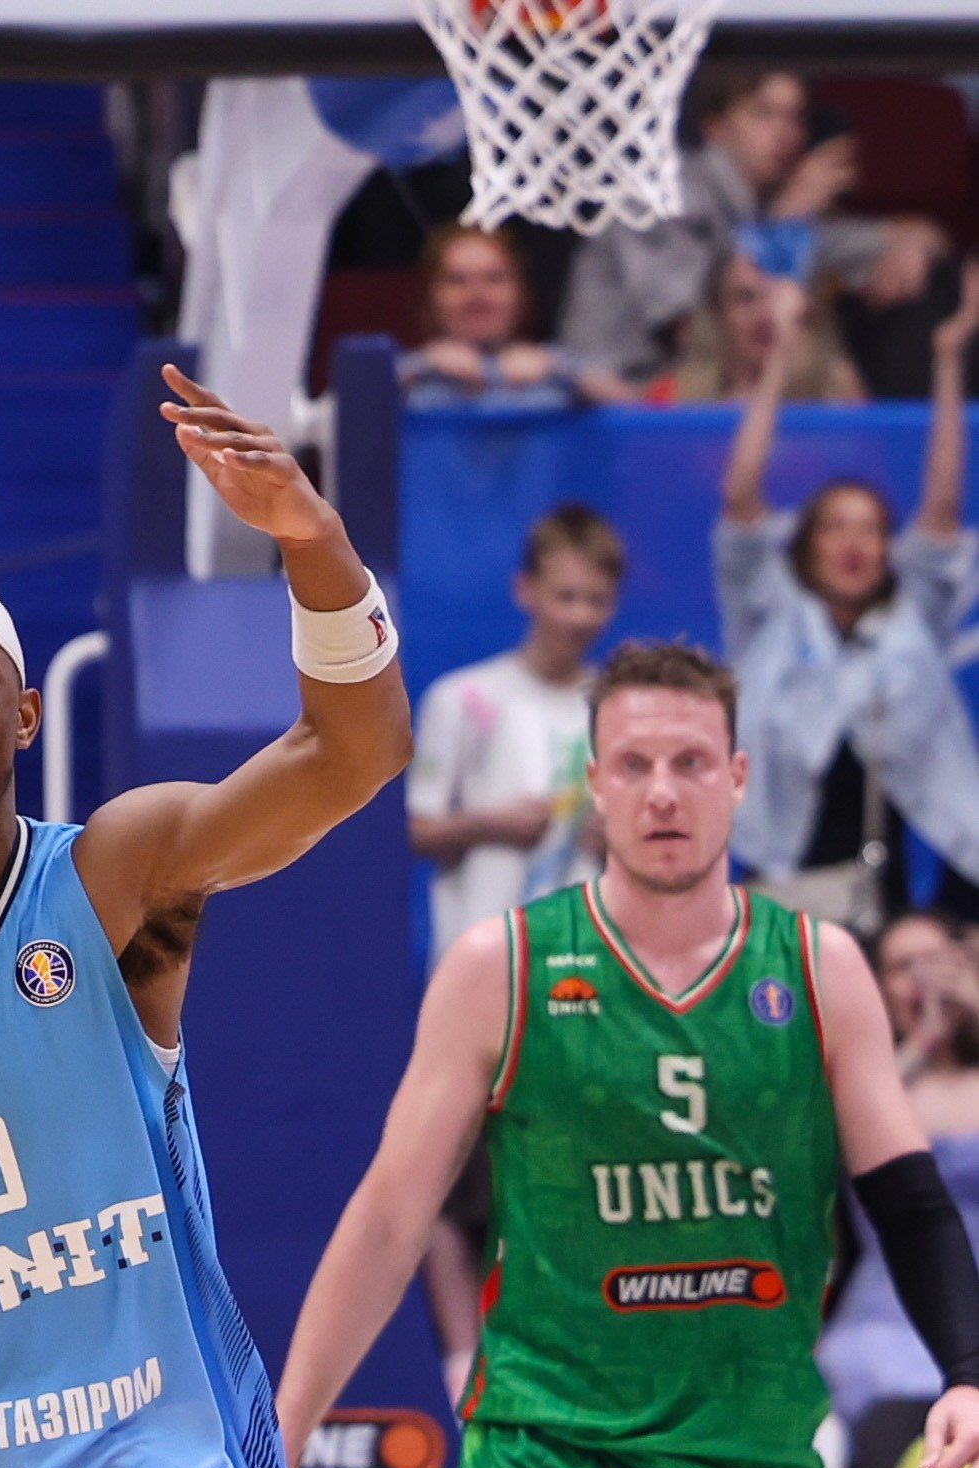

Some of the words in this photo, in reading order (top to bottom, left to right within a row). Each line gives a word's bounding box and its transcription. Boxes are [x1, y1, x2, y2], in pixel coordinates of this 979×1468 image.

[657, 1055, 707, 1134] 5
[593, 1160, 777, 1225] UNICS
[618, 1266, 750, 1304] WINLINE
